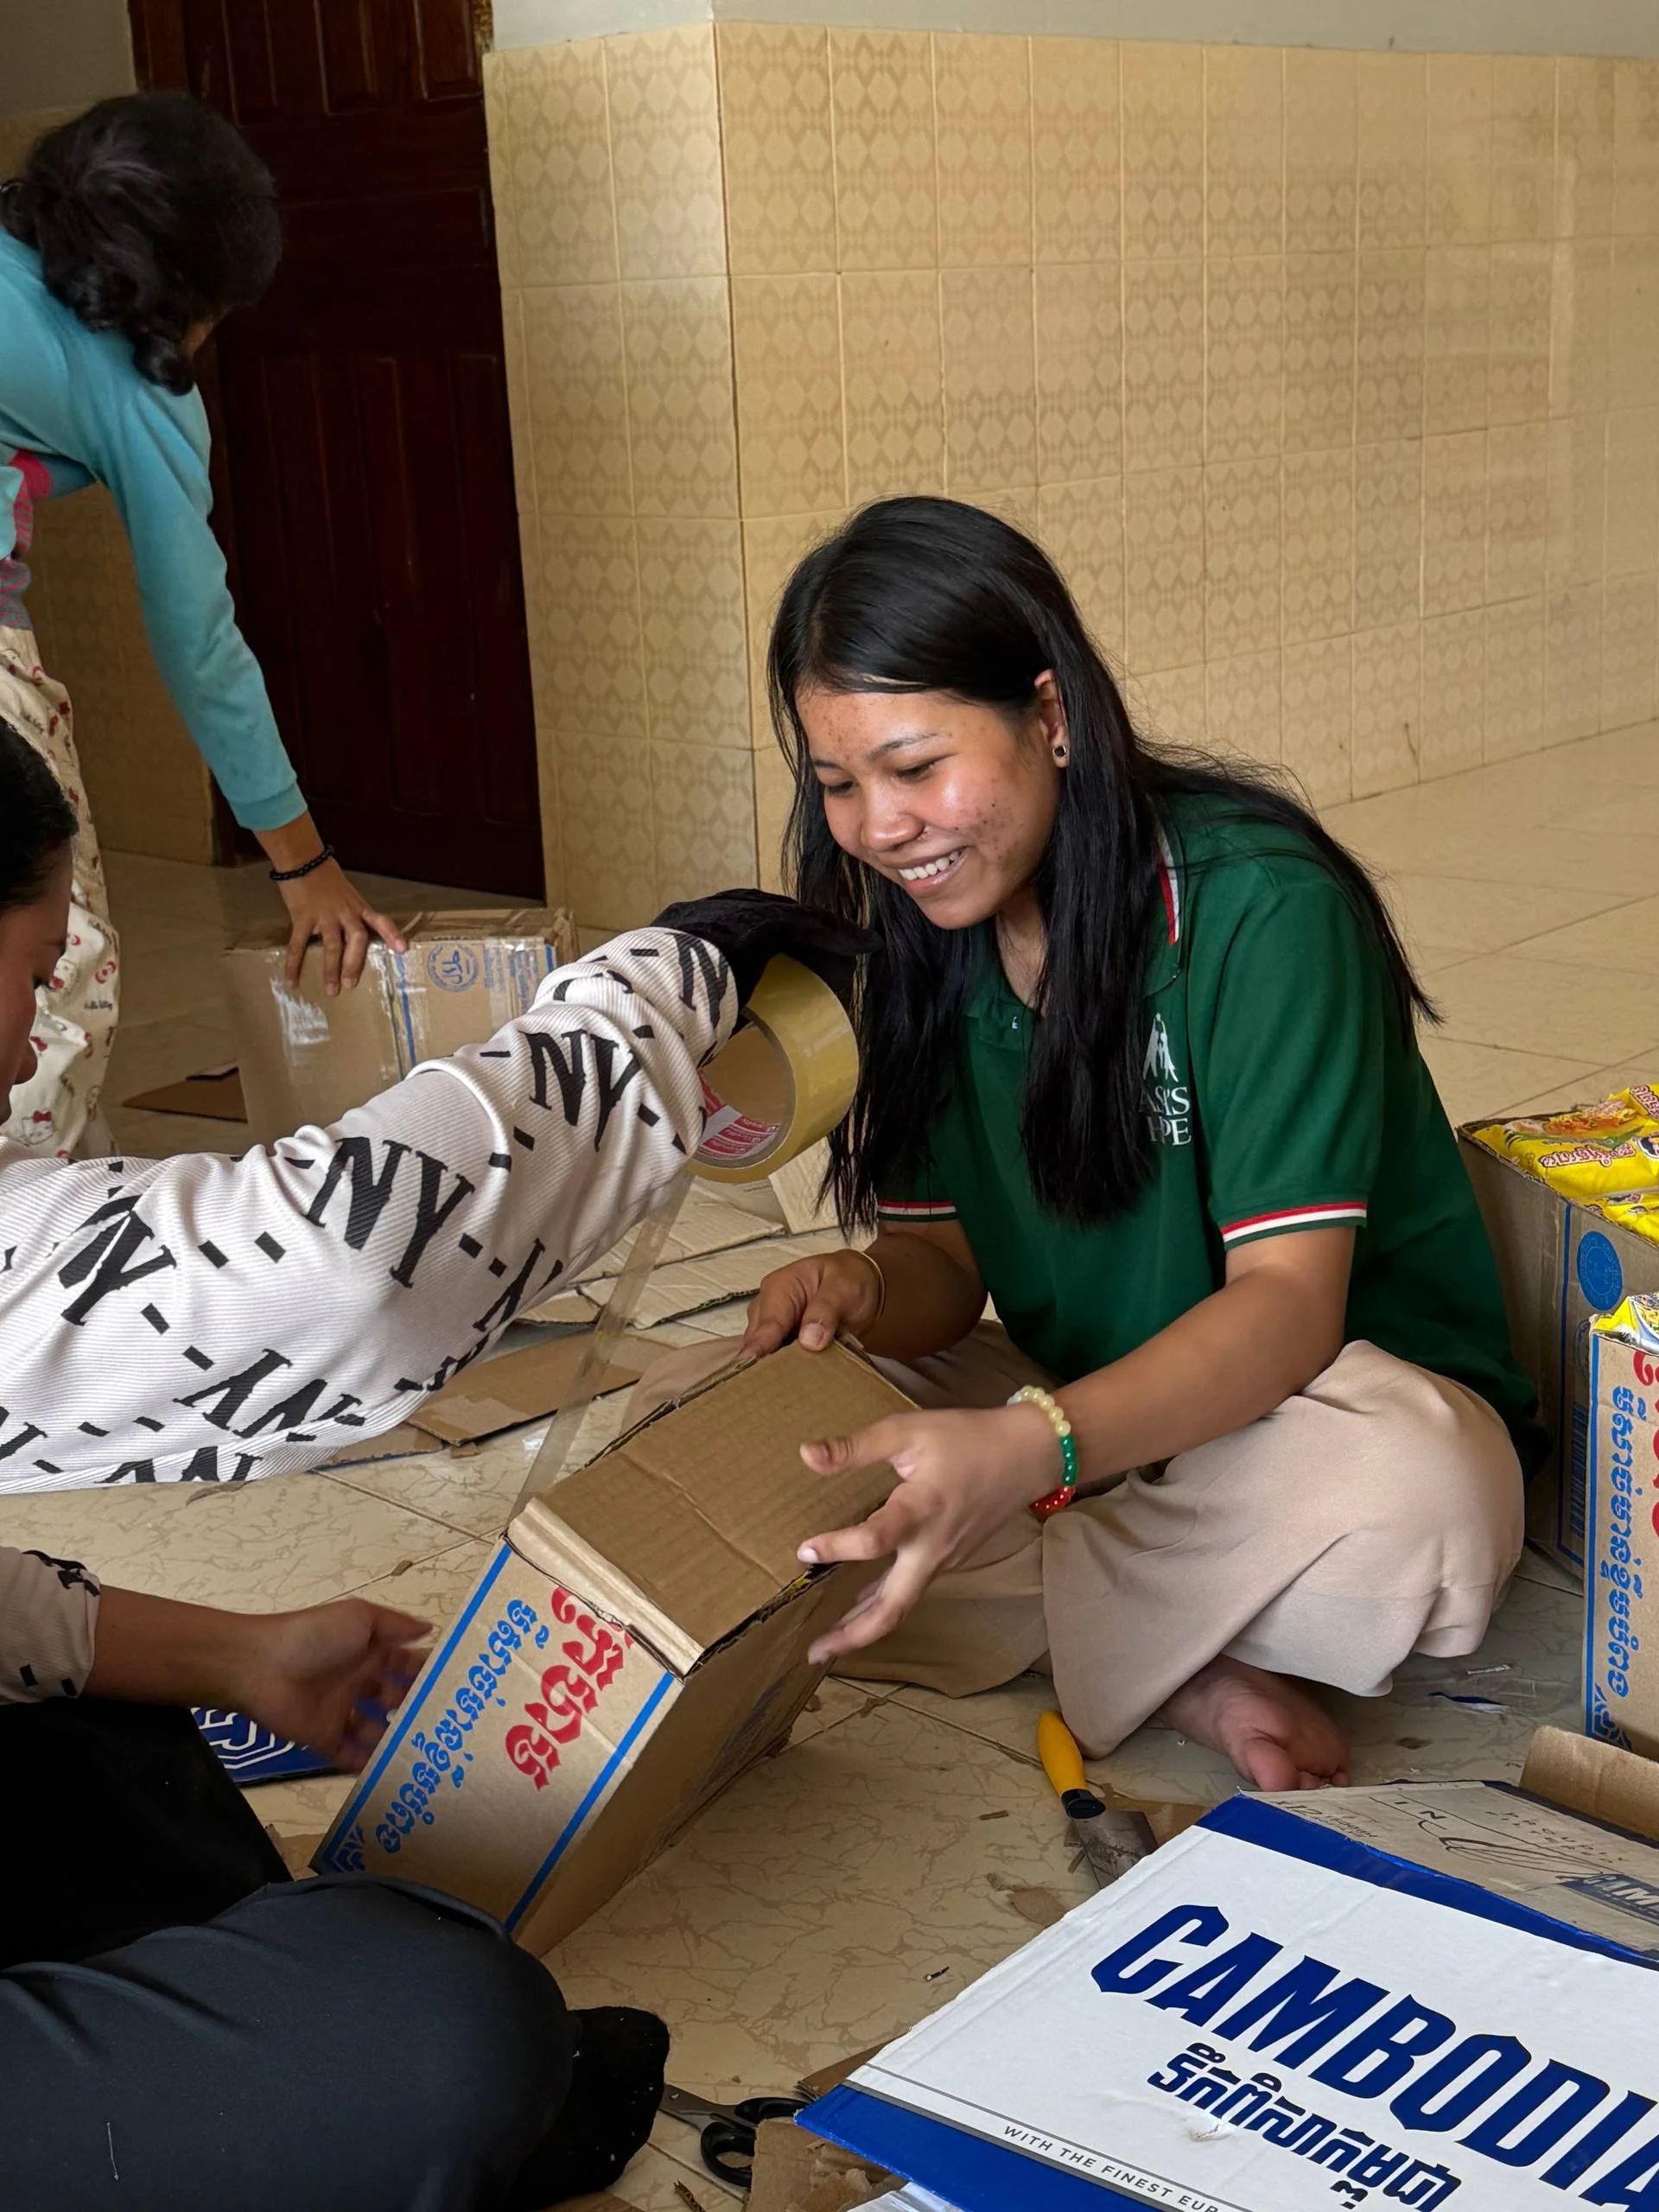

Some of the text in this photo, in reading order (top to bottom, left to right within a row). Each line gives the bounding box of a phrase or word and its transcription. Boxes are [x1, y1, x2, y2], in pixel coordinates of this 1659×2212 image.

[518, 1027, 642, 1153] NY
[306, 1136, 475, 1289] NY
[1004, 2126, 1053, 2152] WITH
[1059, 2148, 1097, 2168] THE
[1102, 2165, 1173, 2197] FINEST
